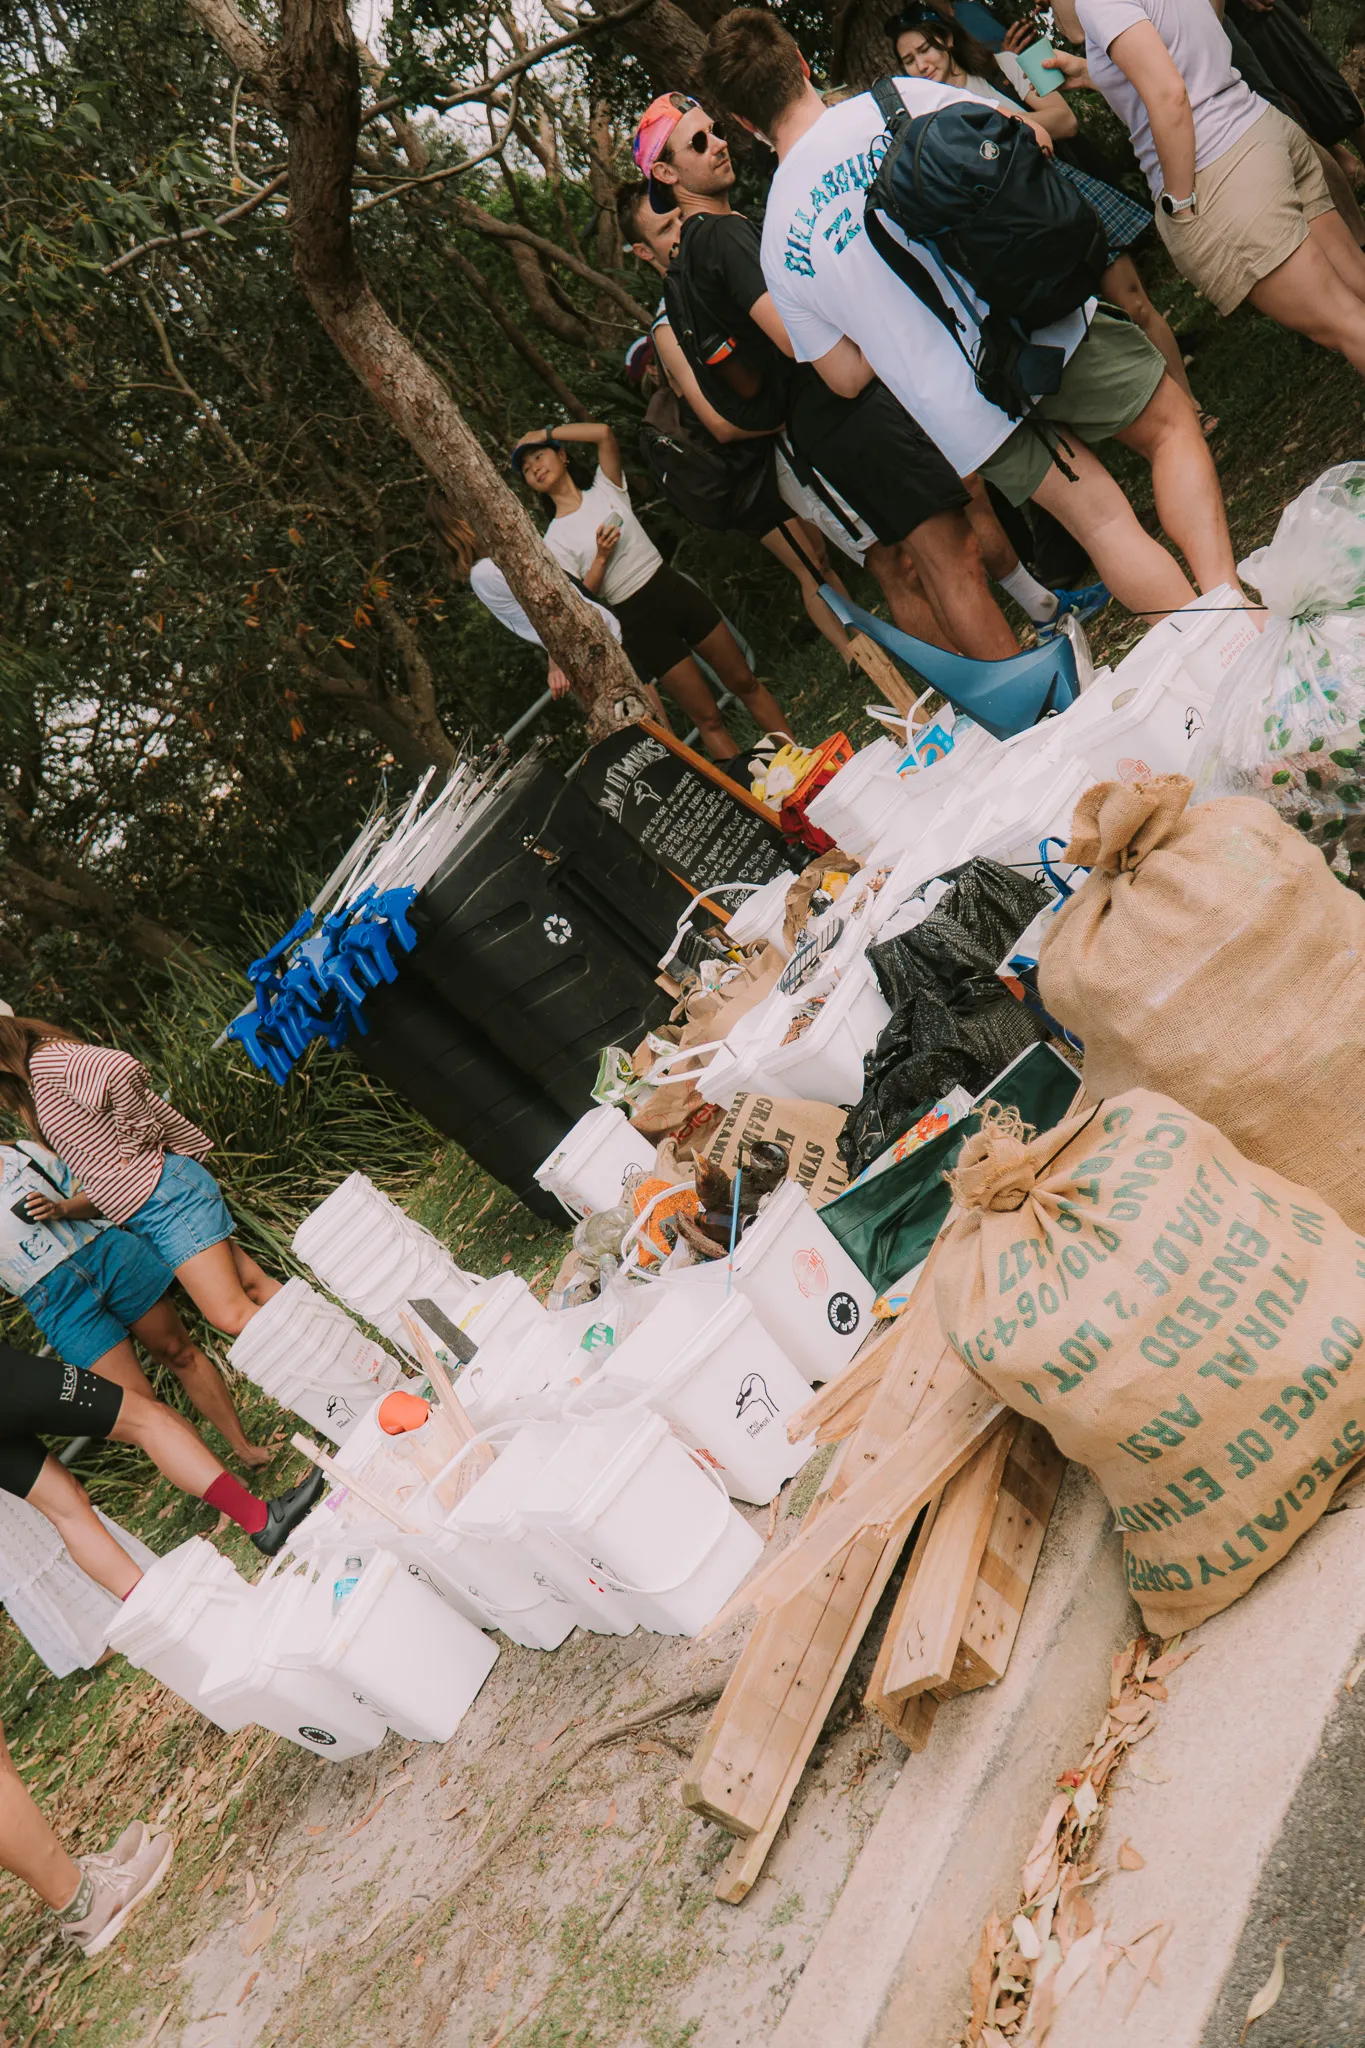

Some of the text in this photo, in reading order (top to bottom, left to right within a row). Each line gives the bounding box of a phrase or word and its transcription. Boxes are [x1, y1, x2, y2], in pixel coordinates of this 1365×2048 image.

[1219, 628, 1255, 669] SUPPORTED
[606, 766, 629, 787] IT
[659, 841, 669, 852] GO
[664, 829, 677, 843] AND
[672, 817, 687, 832] PICK
[666, 843, 677, 857] OFF
[673, 833, 684, 846] THE
[679, 818, 696, 836] BEACH
[672, 839, 693, 863] BRACING
[689, 818, 708, 841] PRESENT
[704, 800, 721, 821] MOMENT
[699, 836, 708, 844] IN
[693, 863, 708, 879] NO
[737, 868, 749, 879] TO
[757, 839, 771, 853] AND
[794, 1141, 825, 1196] SYDN
[797, 1250, 823, 1294] SREME
[830, 1295, 848, 1328] FUTURE
[1103, 1289, 1139, 1320] 2
[1041, 1317, 1112, 1396] LOT
[1120, 1238, 1365, 1534] ODUCE OF ETHIO
[745, 1419, 759, 1434] EMU
[749, 1416, 771, 1440] PARADE
[1117, 1393, 1205, 1465] ARSI
[1125, 1419, 1365, 1593] SPECIALTY COFFE
